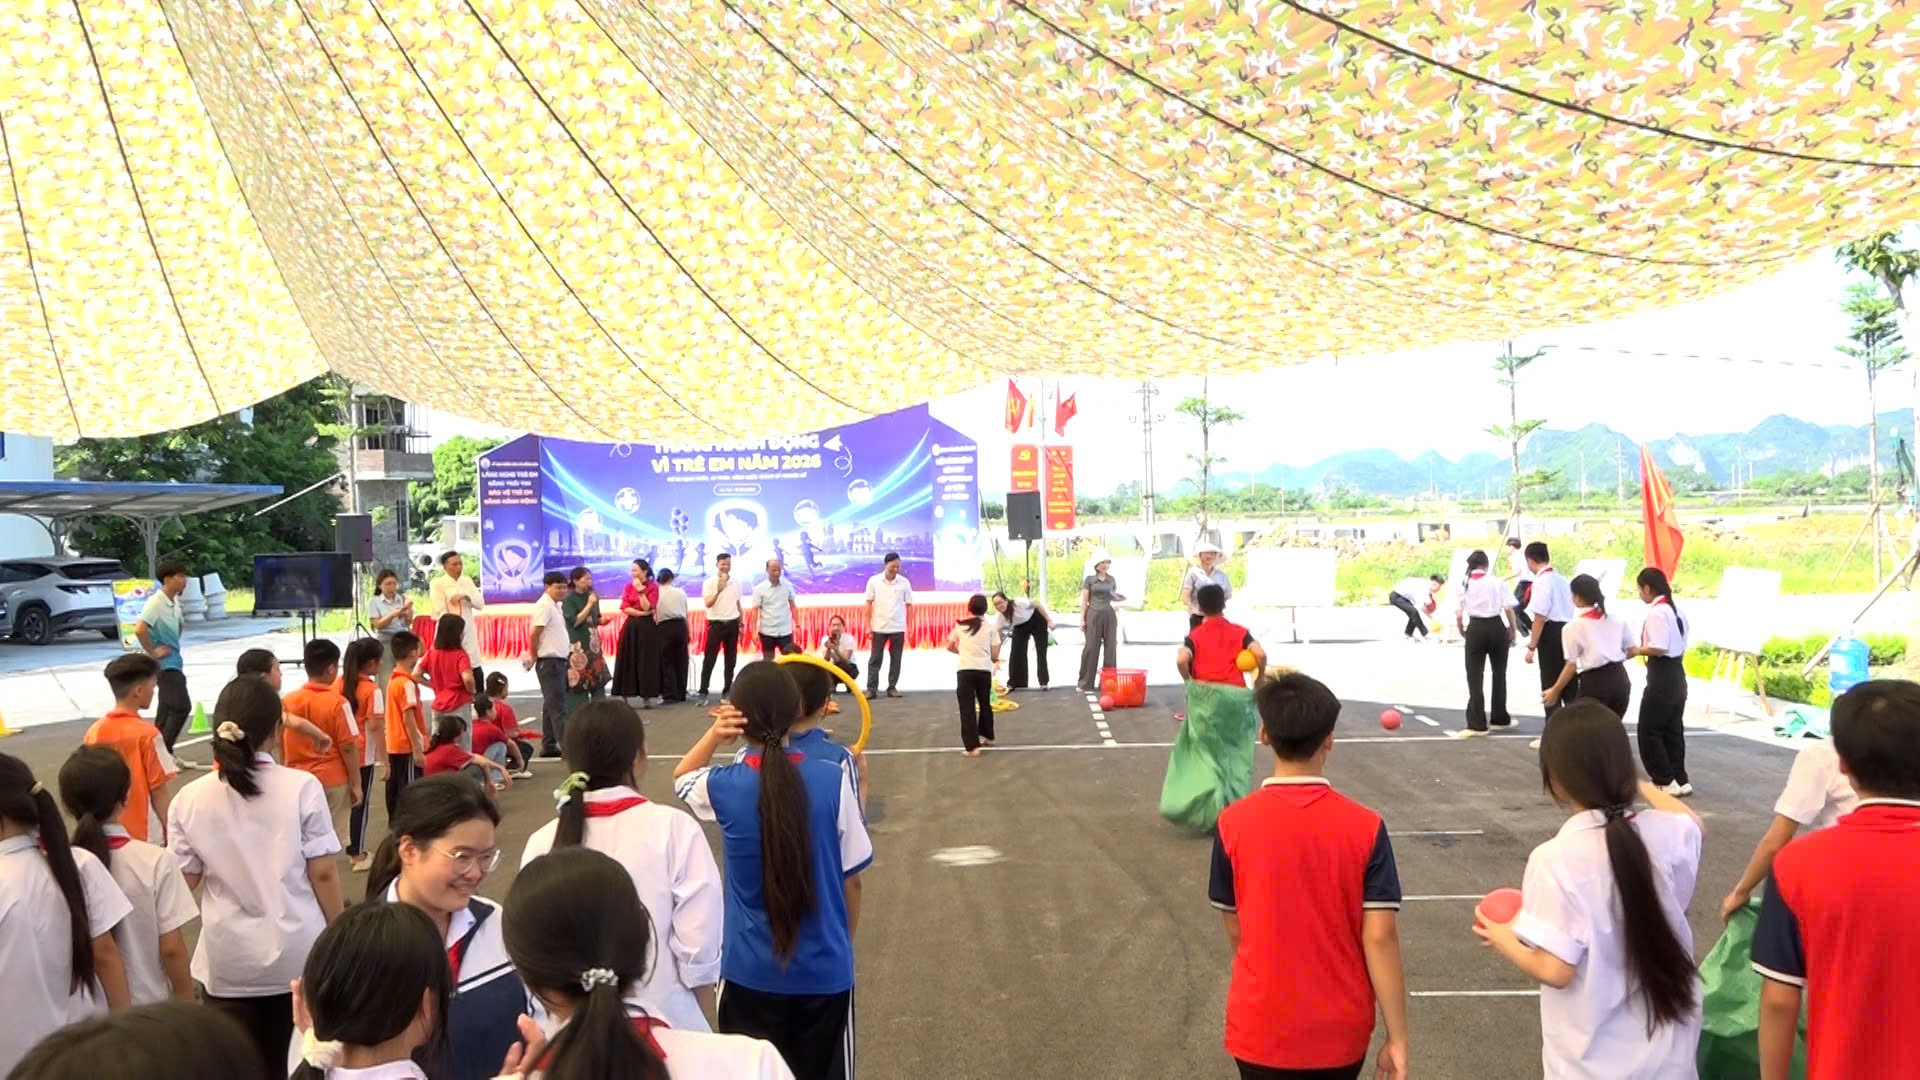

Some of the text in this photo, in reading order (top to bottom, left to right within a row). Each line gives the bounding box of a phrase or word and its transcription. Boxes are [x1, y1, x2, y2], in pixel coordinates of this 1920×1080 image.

[708, 456, 735, 472] EM
[737, 453, 779, 471] NĂM
[781, 454, 821, 470] 2026
